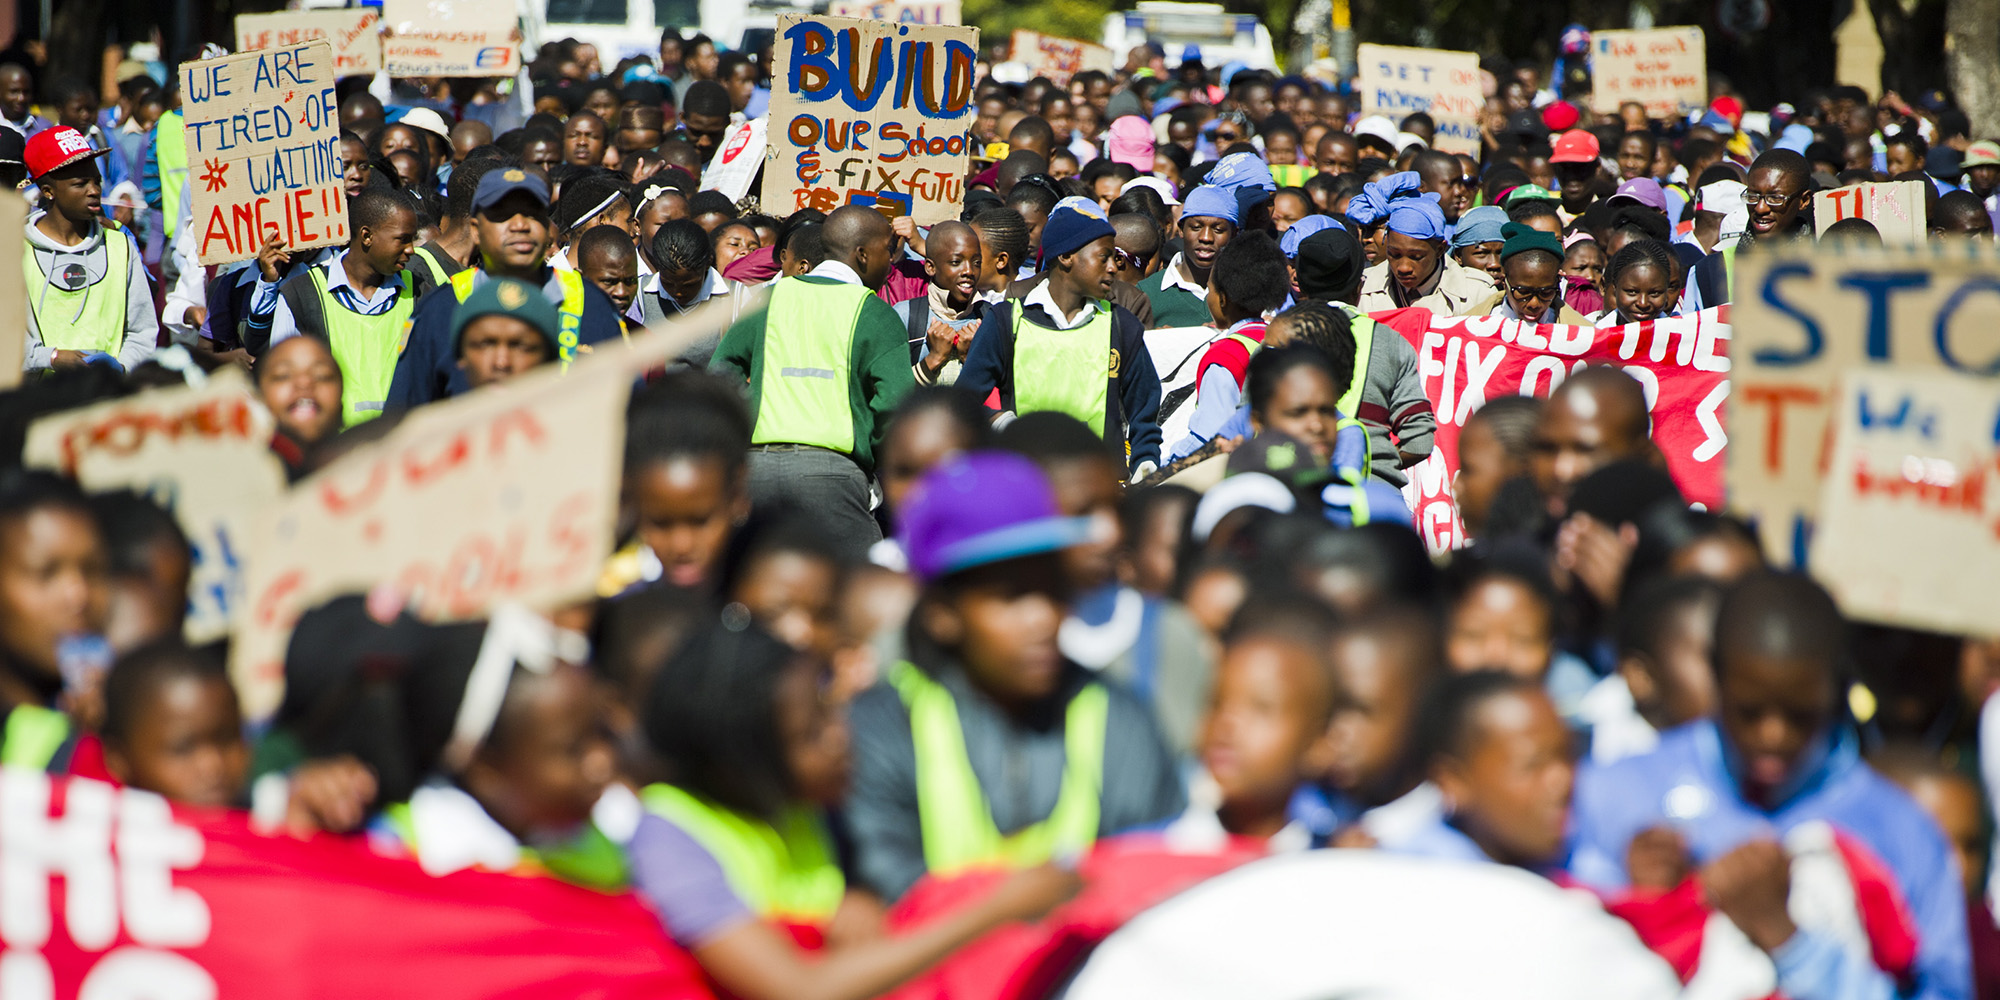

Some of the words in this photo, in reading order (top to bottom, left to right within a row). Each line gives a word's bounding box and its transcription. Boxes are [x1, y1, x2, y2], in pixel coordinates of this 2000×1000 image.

[189, 65, 232, 103] WE
[254, 47, 317, 93] ARE
[1378, 61, 1434, 82] SET
[186, 105, 292, 152] TIRED
[306, 88, 336, 132] OF
[788, 114, 872, 153] OUR
[248, 136, 344, 195] WAITING
[201, 186, 344, 257] ANGIE!!
[1826, 186, 1908, 222] TIK
[1419, 331, 1507, 427] FIX
